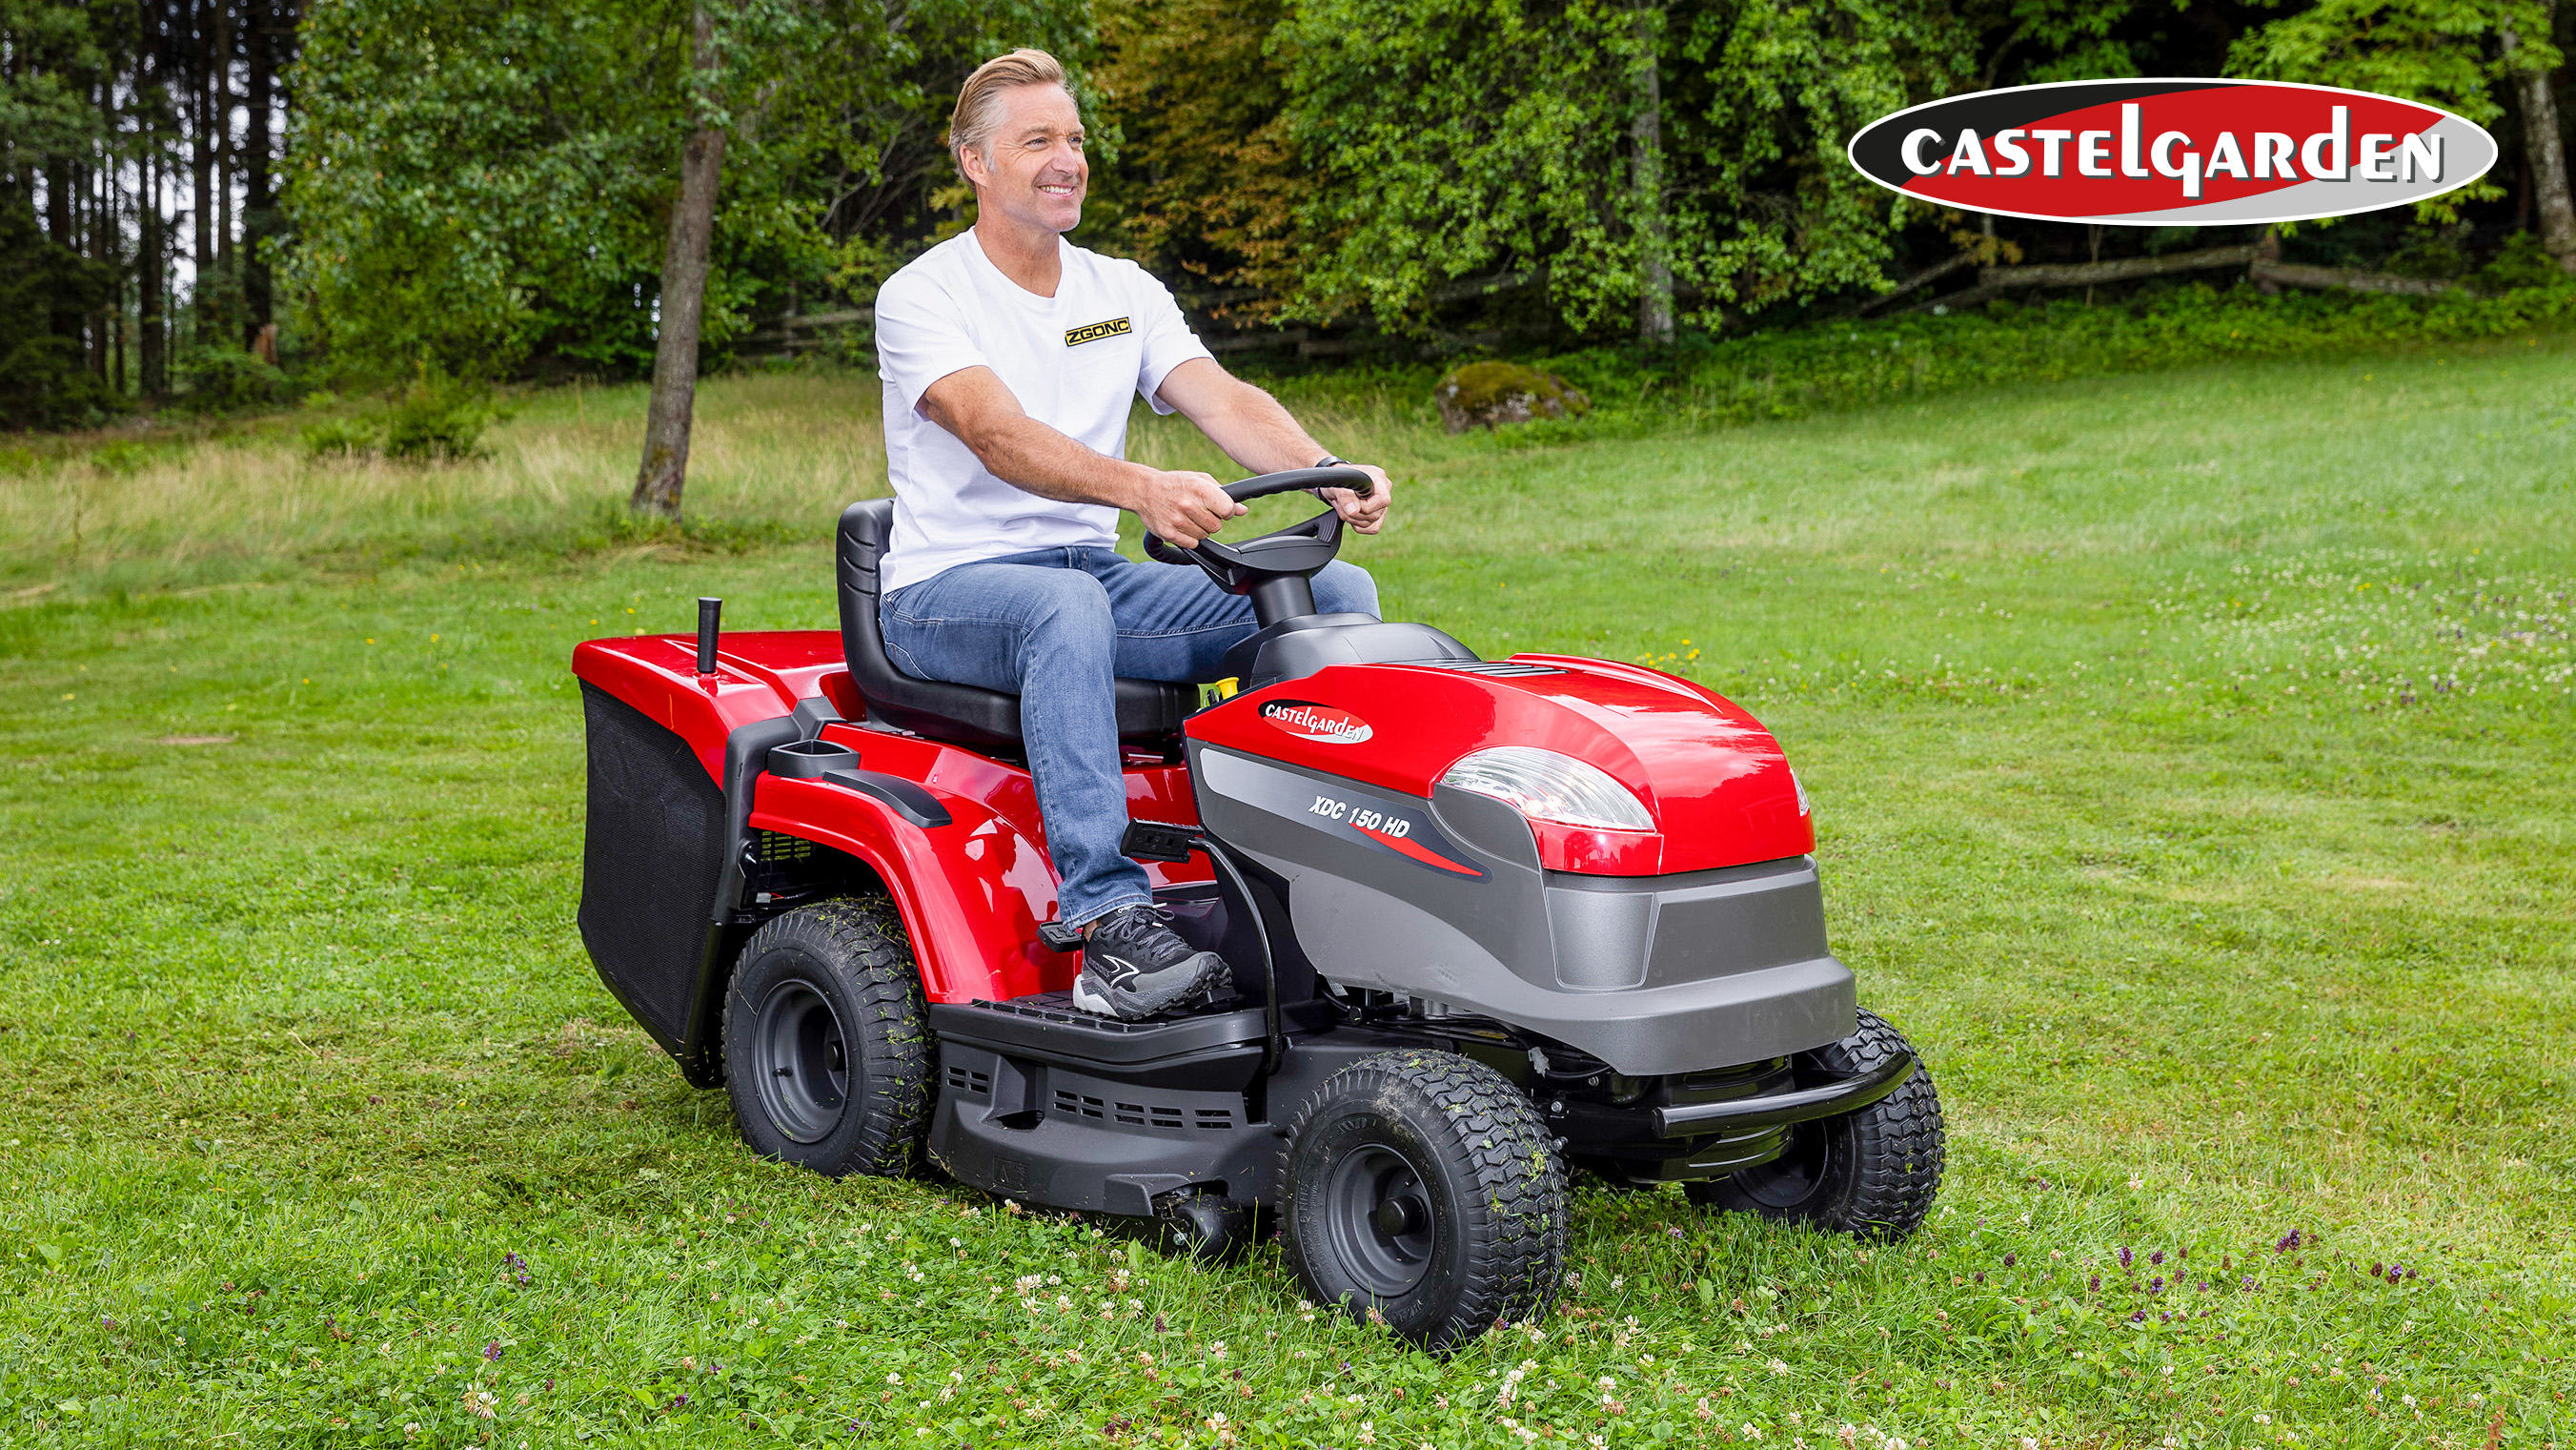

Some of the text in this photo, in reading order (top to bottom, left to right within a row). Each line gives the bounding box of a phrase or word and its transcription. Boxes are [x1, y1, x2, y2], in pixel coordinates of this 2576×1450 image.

[1066, 319, 1130, 344] ZGONC
[1308, 795, 1410, 839] XDC 150 HD
